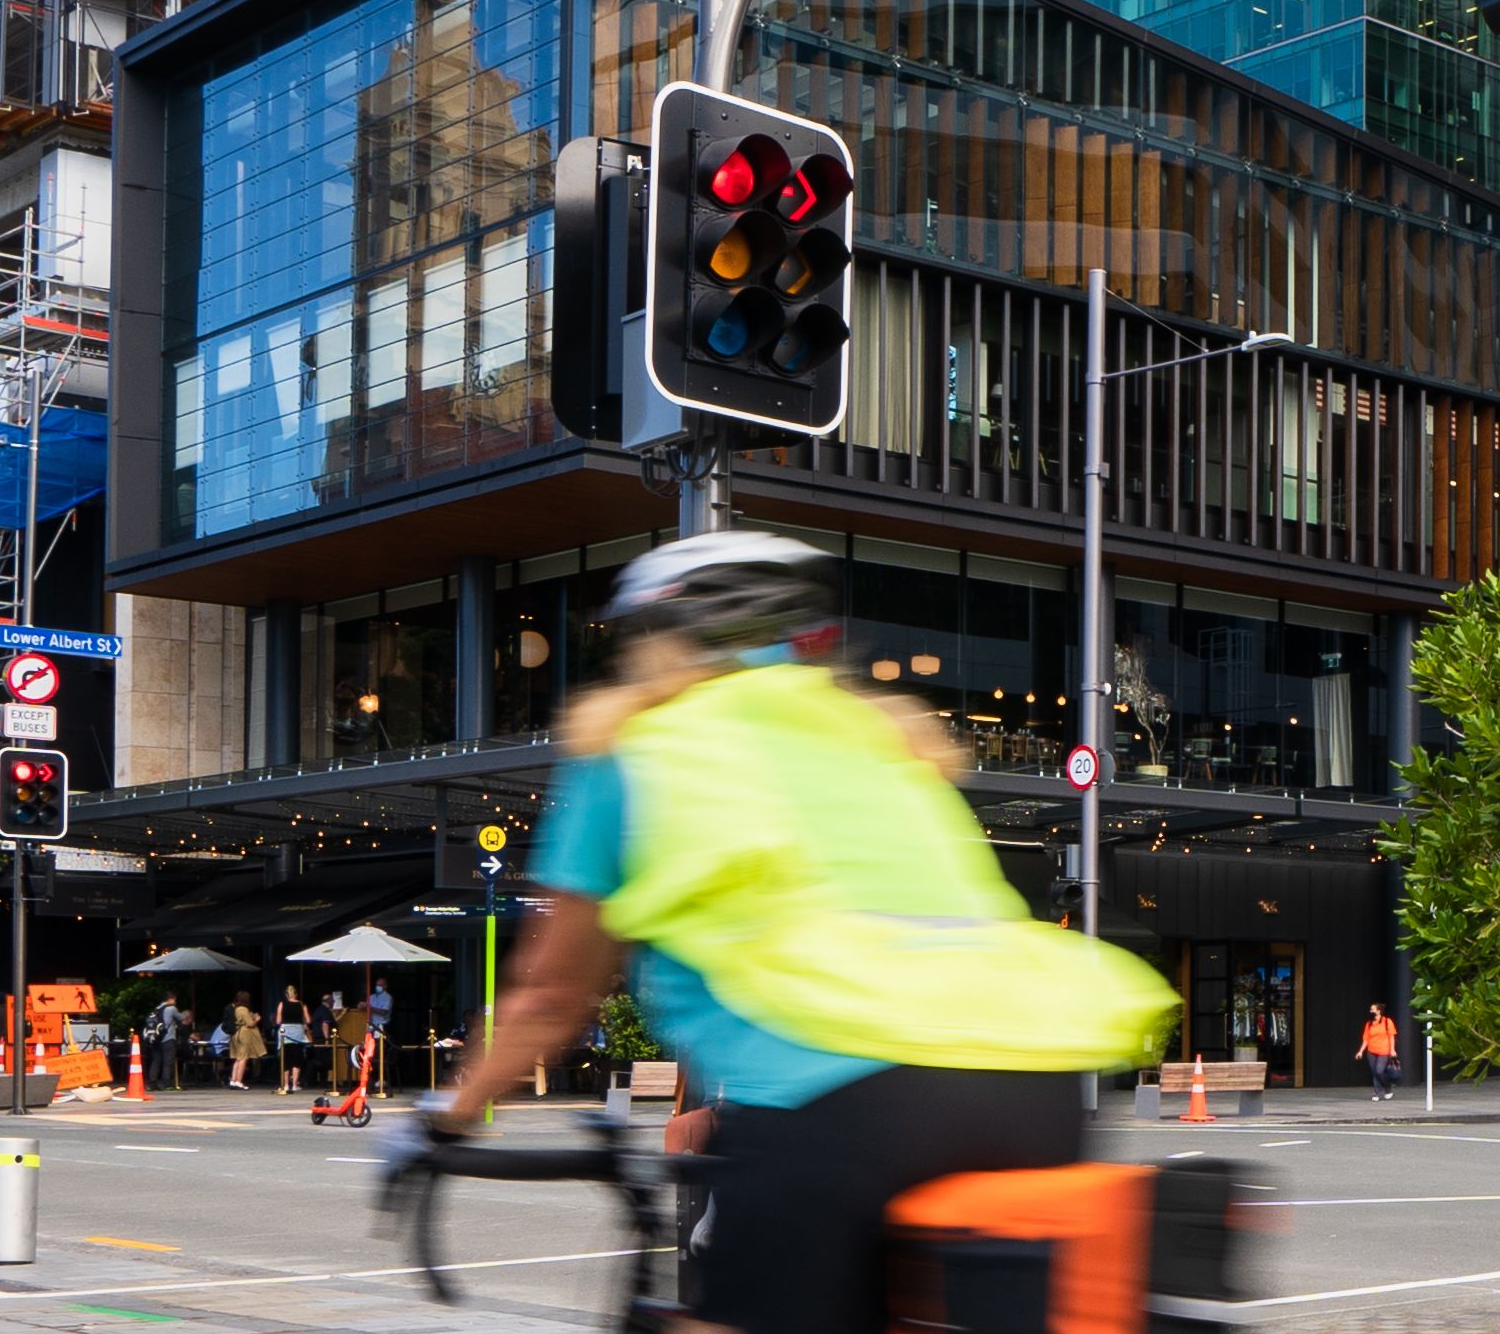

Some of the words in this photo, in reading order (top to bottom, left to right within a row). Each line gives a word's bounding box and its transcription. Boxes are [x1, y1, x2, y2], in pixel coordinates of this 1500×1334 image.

[3, 628, 46, 646] Lower
[48, 633, 93, 651] Albert
[97, 638, 112, 653] St
[10, 709, 50, 722] EXCEPT
[13, 721, 49, 734] BUSES
[1074, 757, 1092, 774] 20
